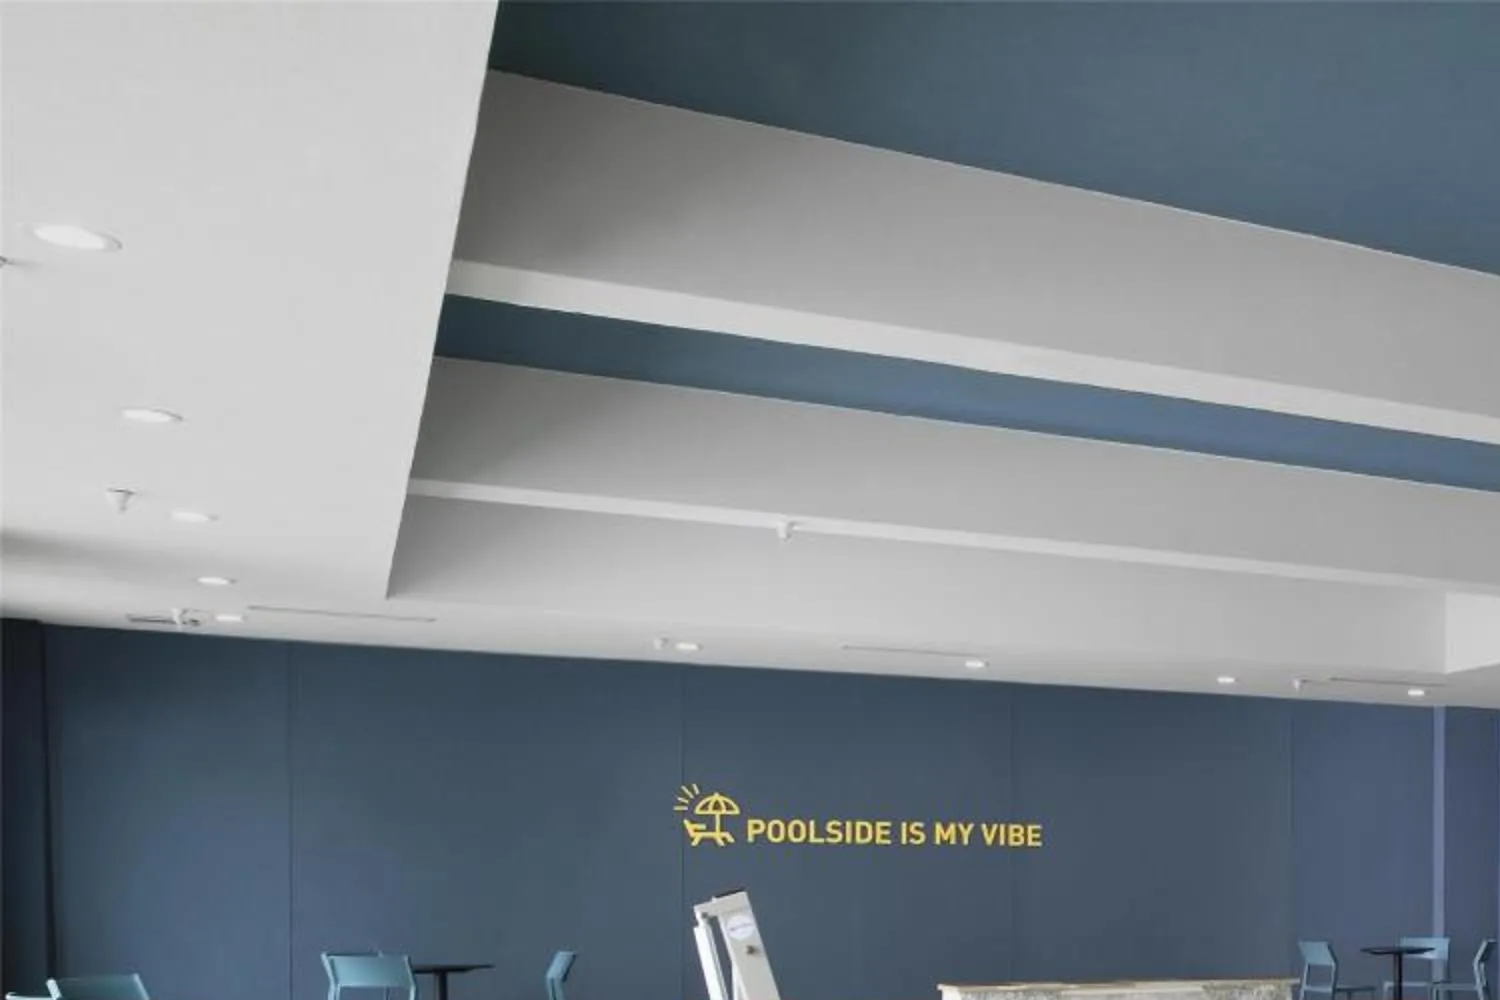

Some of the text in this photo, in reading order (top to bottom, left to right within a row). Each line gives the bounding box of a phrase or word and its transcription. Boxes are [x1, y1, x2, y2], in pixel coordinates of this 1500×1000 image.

[747, 819, 1042, 847] POOLSIDE IS MY VIBE
